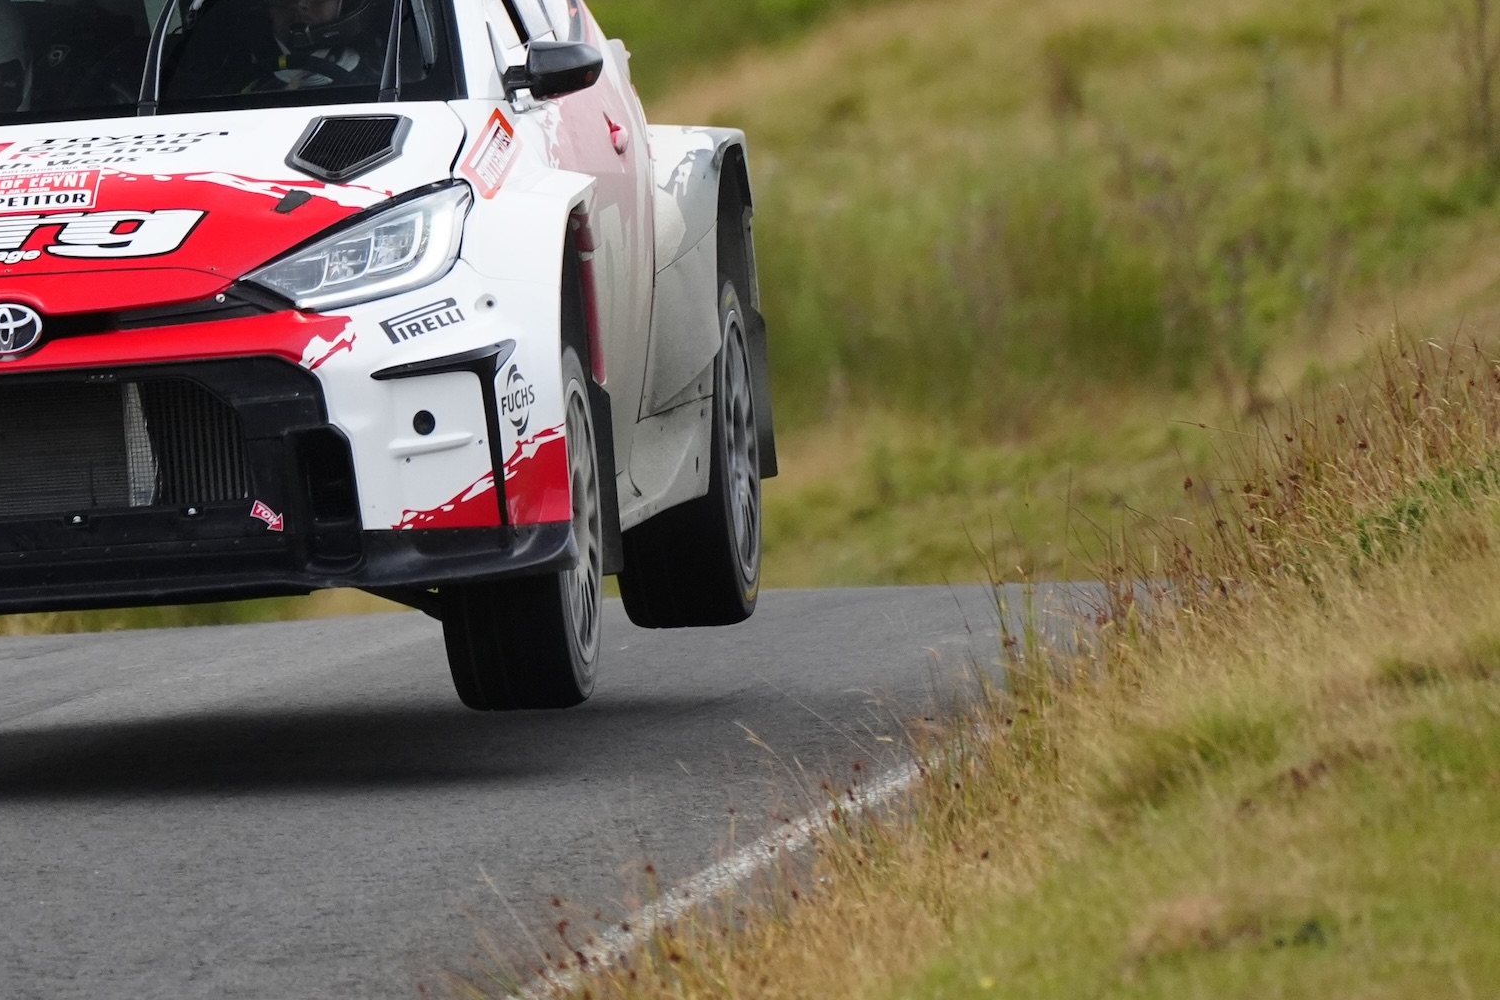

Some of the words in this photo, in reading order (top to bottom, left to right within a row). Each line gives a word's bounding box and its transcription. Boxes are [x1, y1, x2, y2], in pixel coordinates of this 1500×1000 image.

[19, 138, 202, 152] GAZOO
[35, 131, 229, 145] TOYOTA
[8, 146, 188, 161] Racing
[46, 156, 141, 167] Wells
[0, 178, 24, 189] OF
[32, 172, 91, 189] EPYNT
[379, 297, 465, 344] PIRELLI
[501, 384, 535, 416] FUCHS
[255, 504, 281, 526] TOW
